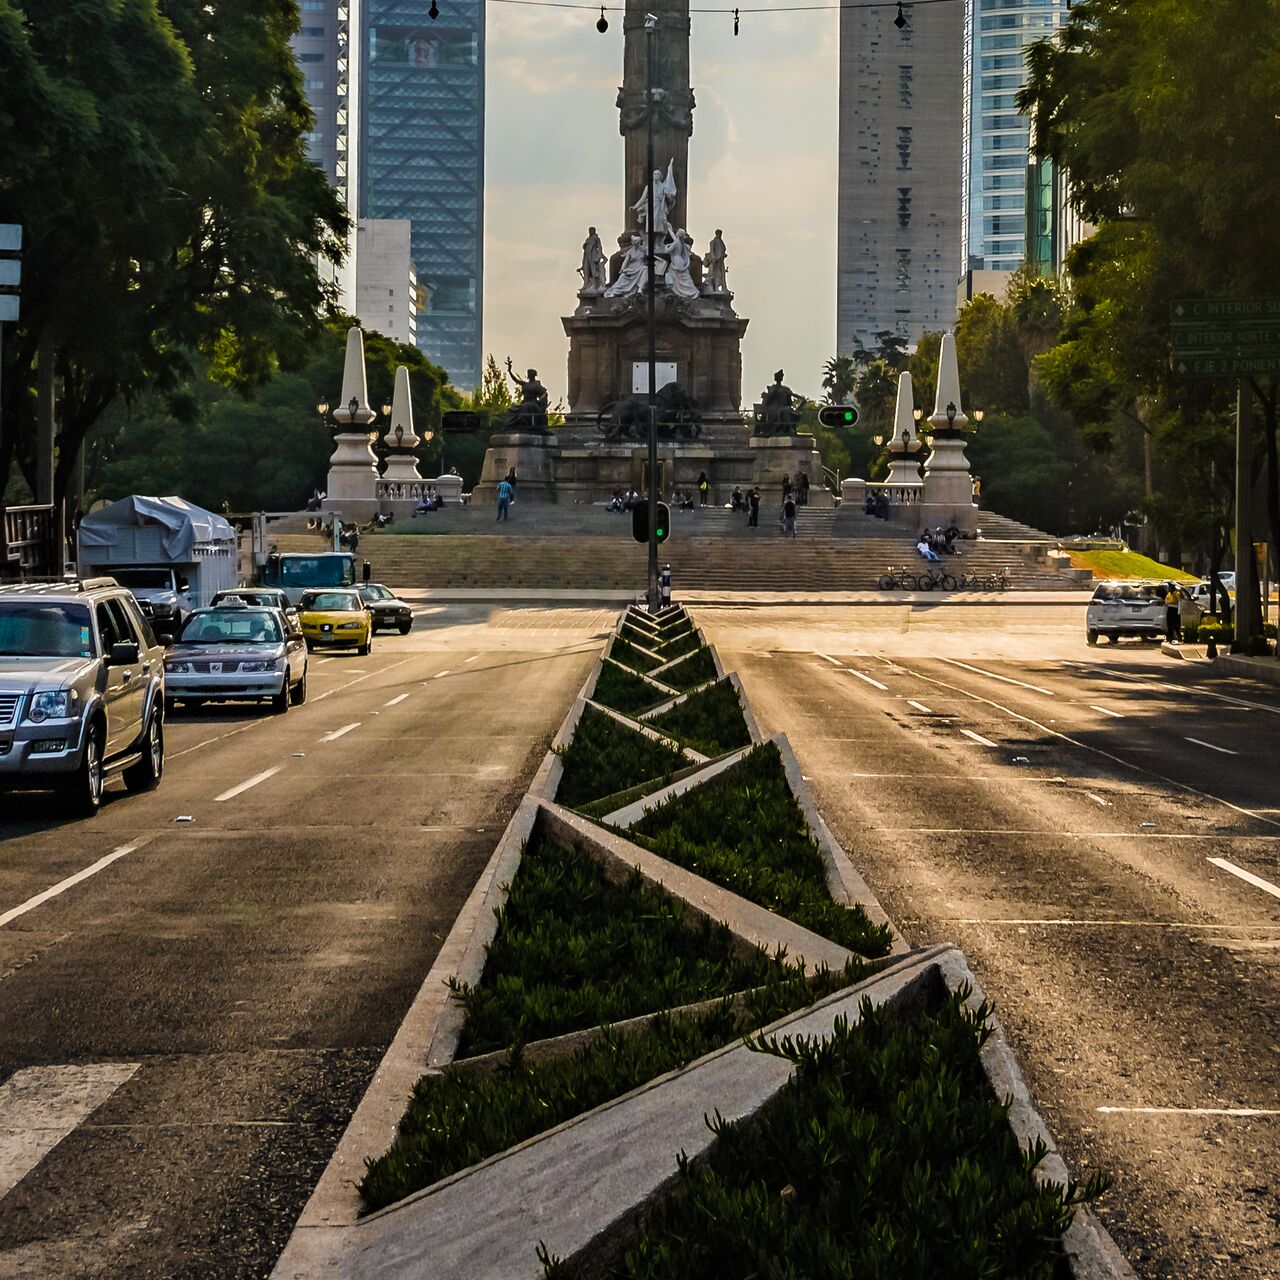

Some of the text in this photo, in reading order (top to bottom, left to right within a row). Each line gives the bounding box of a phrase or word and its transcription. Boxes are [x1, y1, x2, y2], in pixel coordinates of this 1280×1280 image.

[1208, 302, 1264, 315] INTERIOR
[1187, 332, 1234, 345] INTERIOR
[1238, 331, 1271, 343] NORTE
[1193, 361, 1217, 373] EJE
[1221, 360, 1228, 372] 2
